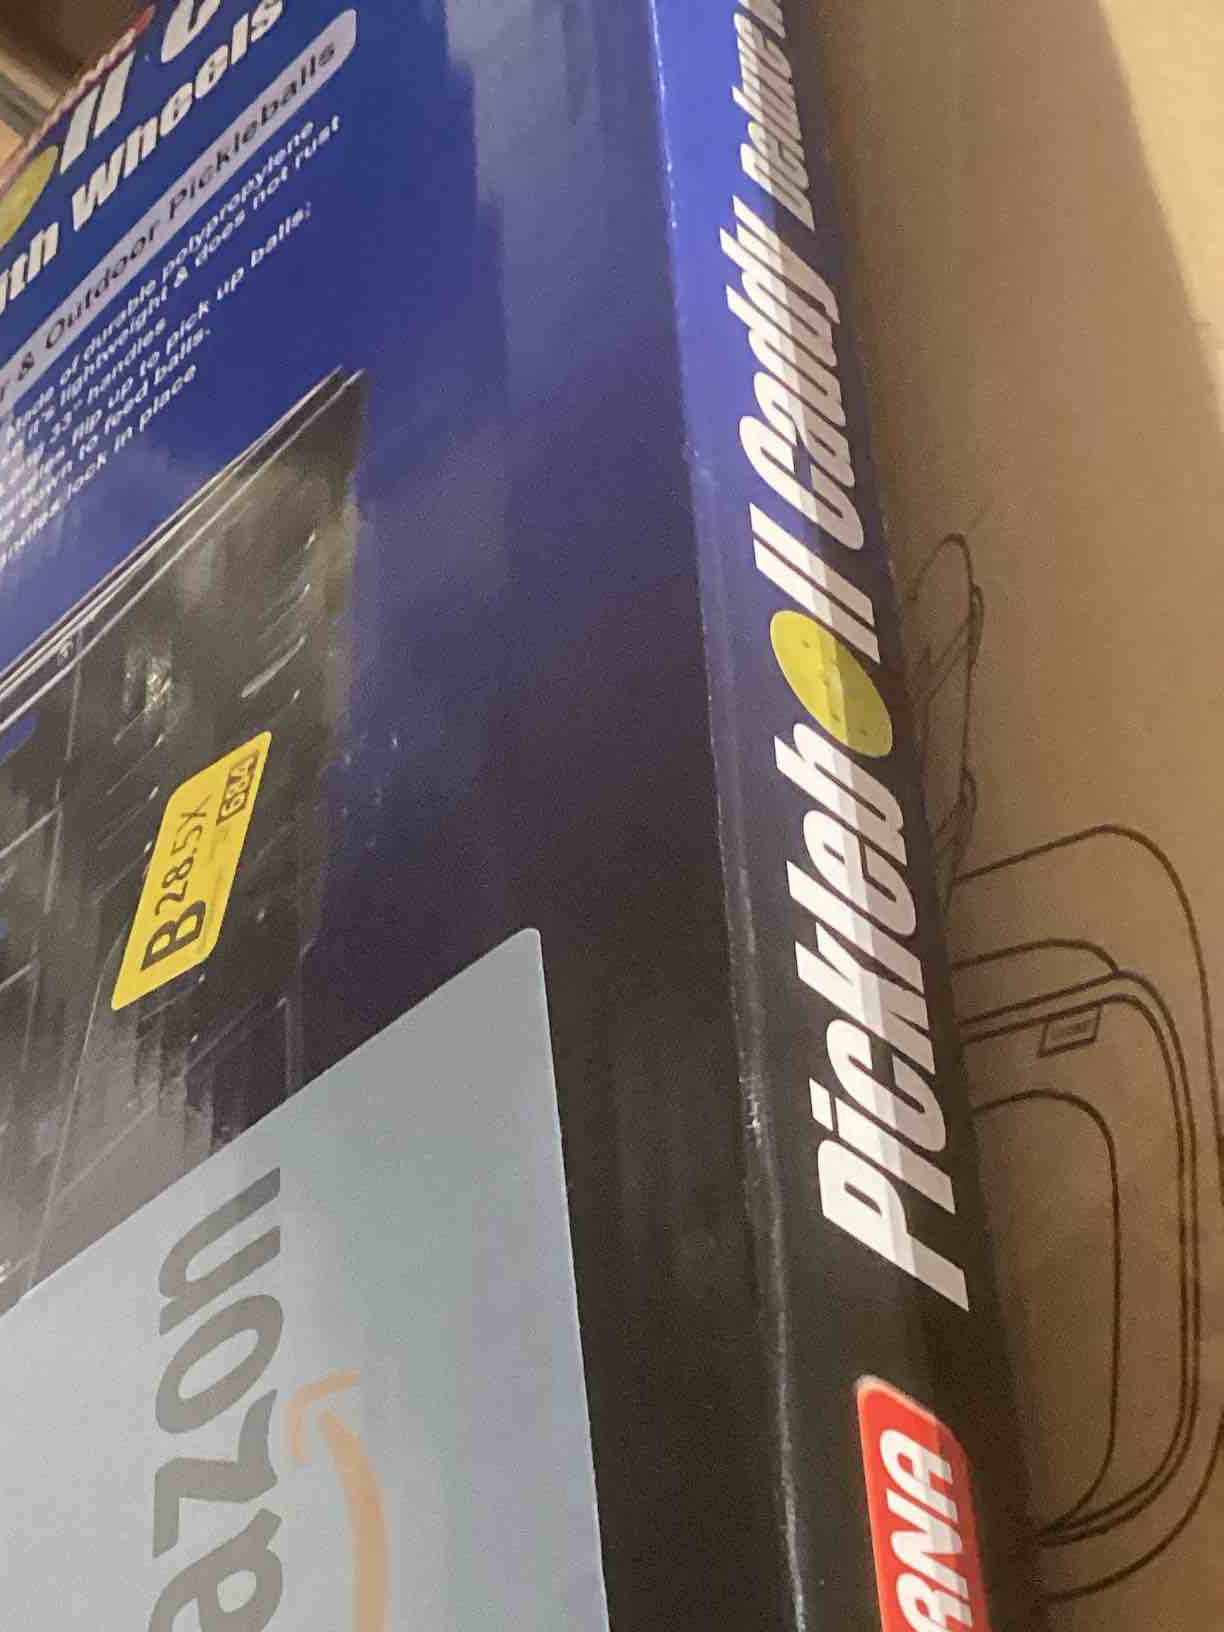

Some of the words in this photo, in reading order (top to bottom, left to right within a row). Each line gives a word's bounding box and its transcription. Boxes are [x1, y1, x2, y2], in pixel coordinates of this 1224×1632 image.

[15, 350, 37, 386] &
[43, 218, 159, 351] Outdoor
[166, 38, 339, 222] Pickleballs
[59, 283, 168, 409] lightweight
[173, 262, 188, 290] &
[194, 206, 245, 270] does
[252, 161, 288, 211] not
[293, 111, 339, 170] rust
[60, 355, 79, 388] of
[83, 273, 155, 363] durable
[161, 117, 313, 284] polypropylene
[87, 313, 166, 405] handles
[108, 371, 133, 412] up
[138, 345, 160, 379] to
[165, 294, 208, 356] pick
[216, 262, 245, 303] up
[113, 422, 135, 455] in
[139, 363, 199, 437] place
[718, 195, 864, 550] Caddy
[78, 429, 97, 463] to
